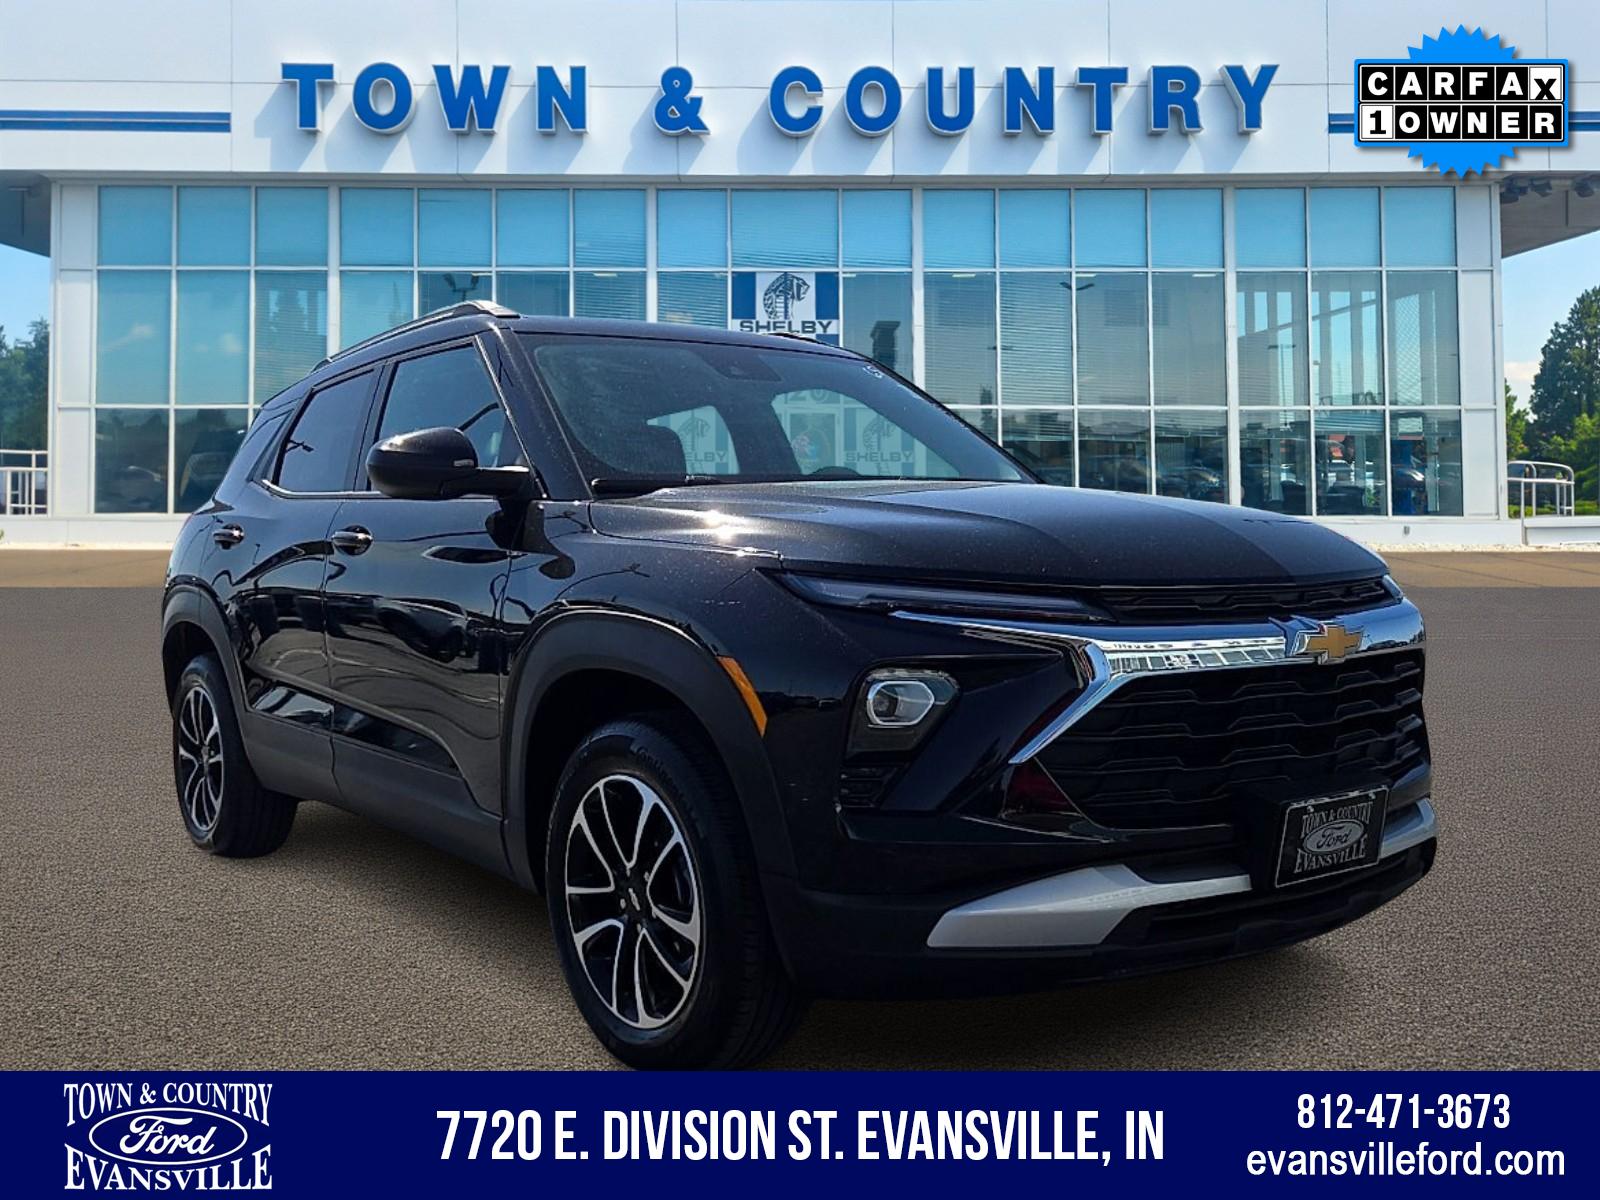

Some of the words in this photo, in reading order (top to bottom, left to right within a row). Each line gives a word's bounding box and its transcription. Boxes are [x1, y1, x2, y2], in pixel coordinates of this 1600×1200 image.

[281, 62, 588, 134] TOWN
[653, 66, 709, 134] &
[768, 64, 1279, 135] COUNTRY
[740, 320, 832, 333] SHELBY
[845, 451, 912, 462] SHELBY
[1300, 811, 1327, 839] TOWN
[1336, 801, 1374, 825] COUNTRY
[1316, 824, 1353, 849] Ford
[1294, 834, 1368, 874] EVANSVILLE
